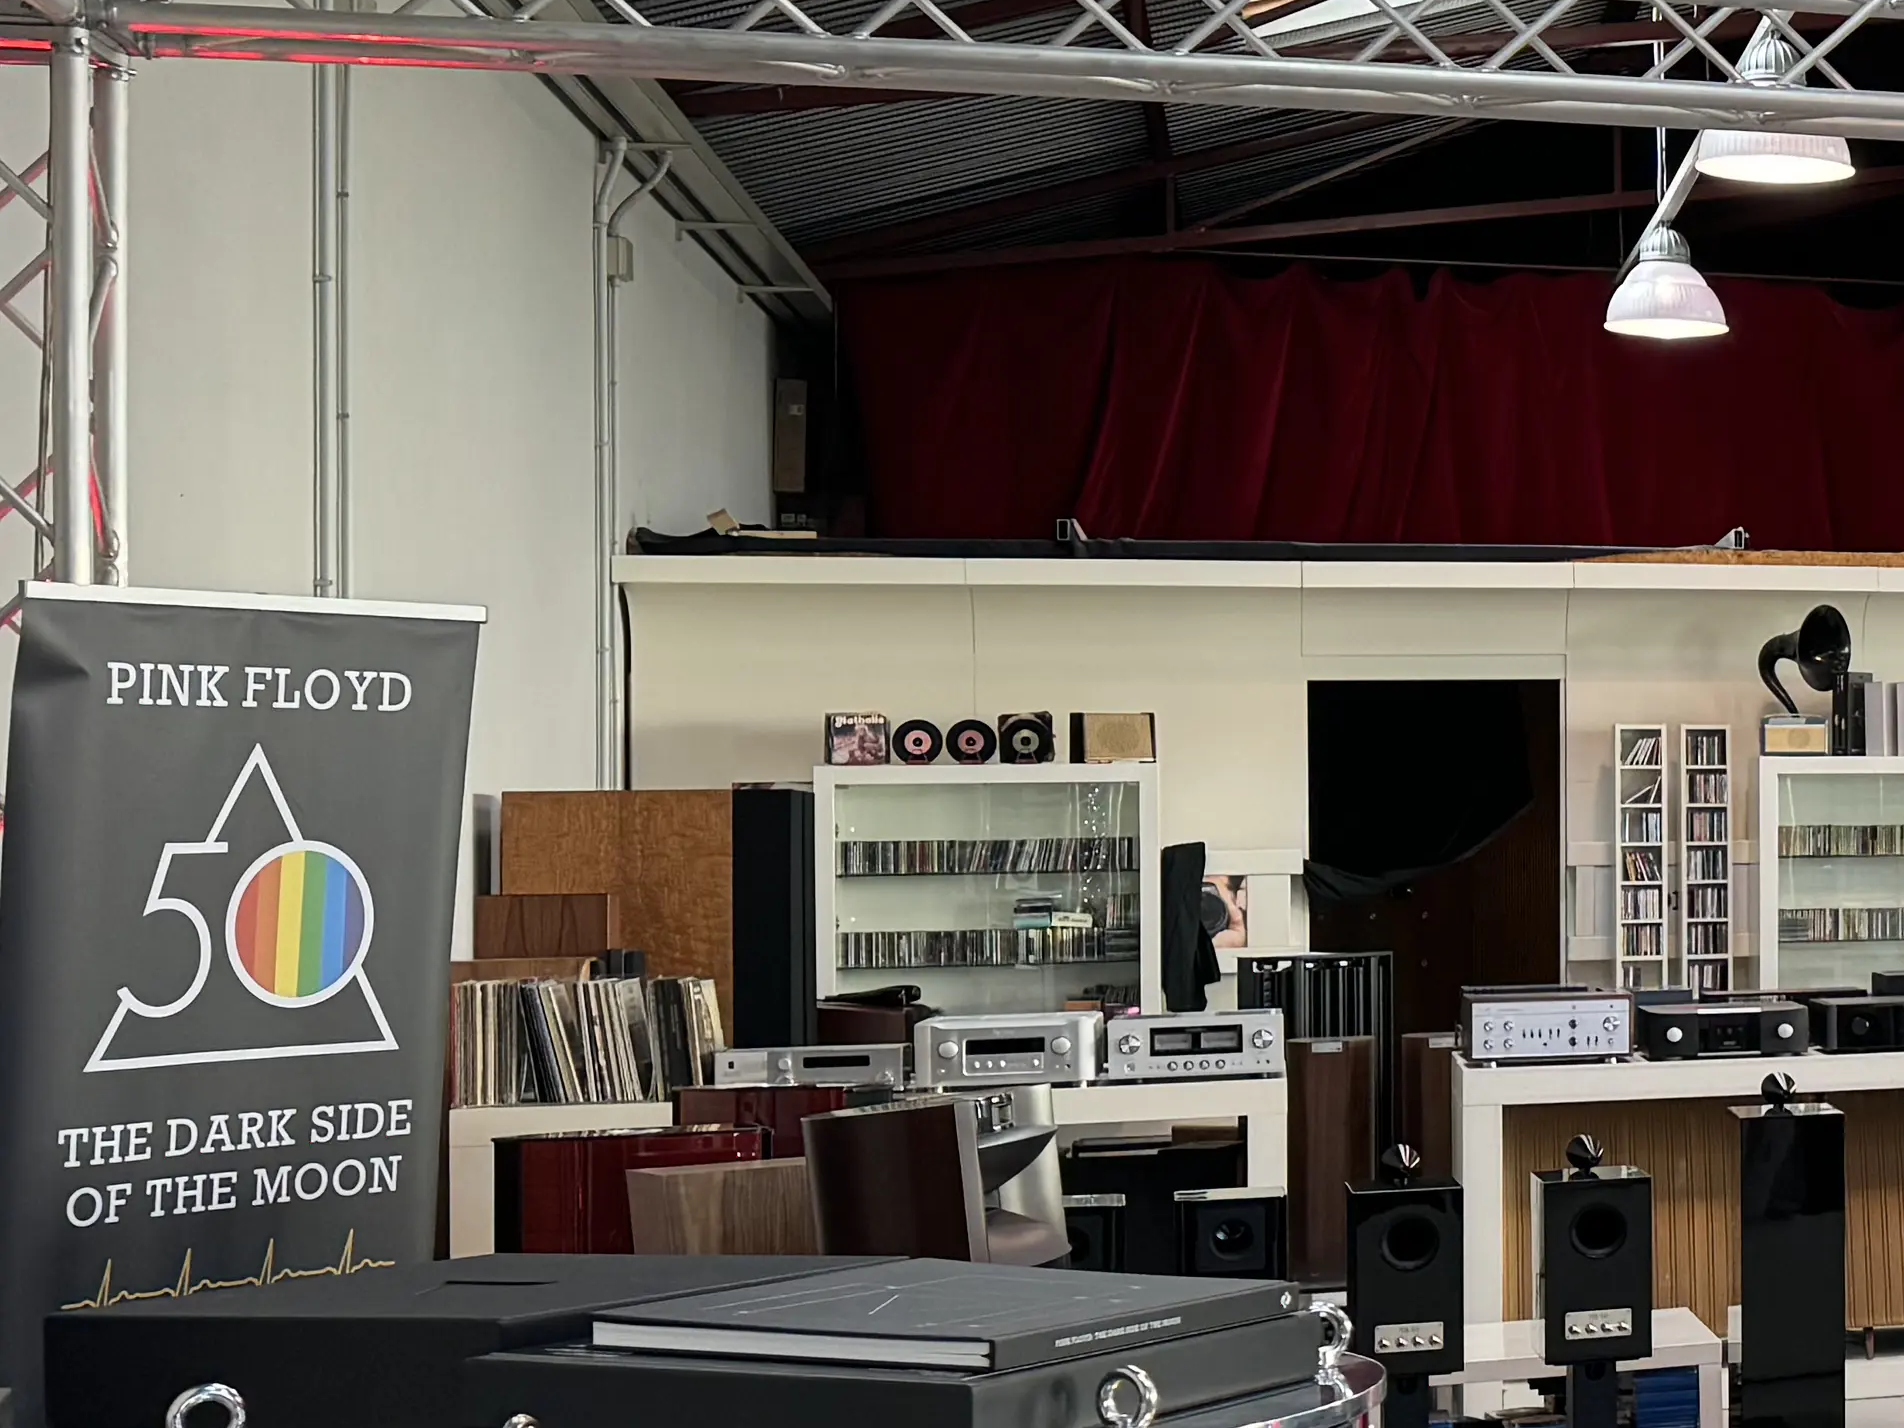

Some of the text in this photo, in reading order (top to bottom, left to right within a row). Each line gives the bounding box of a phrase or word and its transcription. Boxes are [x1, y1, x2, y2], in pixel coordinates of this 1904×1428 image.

[106, 661, 412, 712] PINK FLOYD
[117, 839, 376, 1019] 50
[57, 1099, 413, 1168] THE DARK SIDE
[66, 1154, 403, 1227] OF THE MOON
